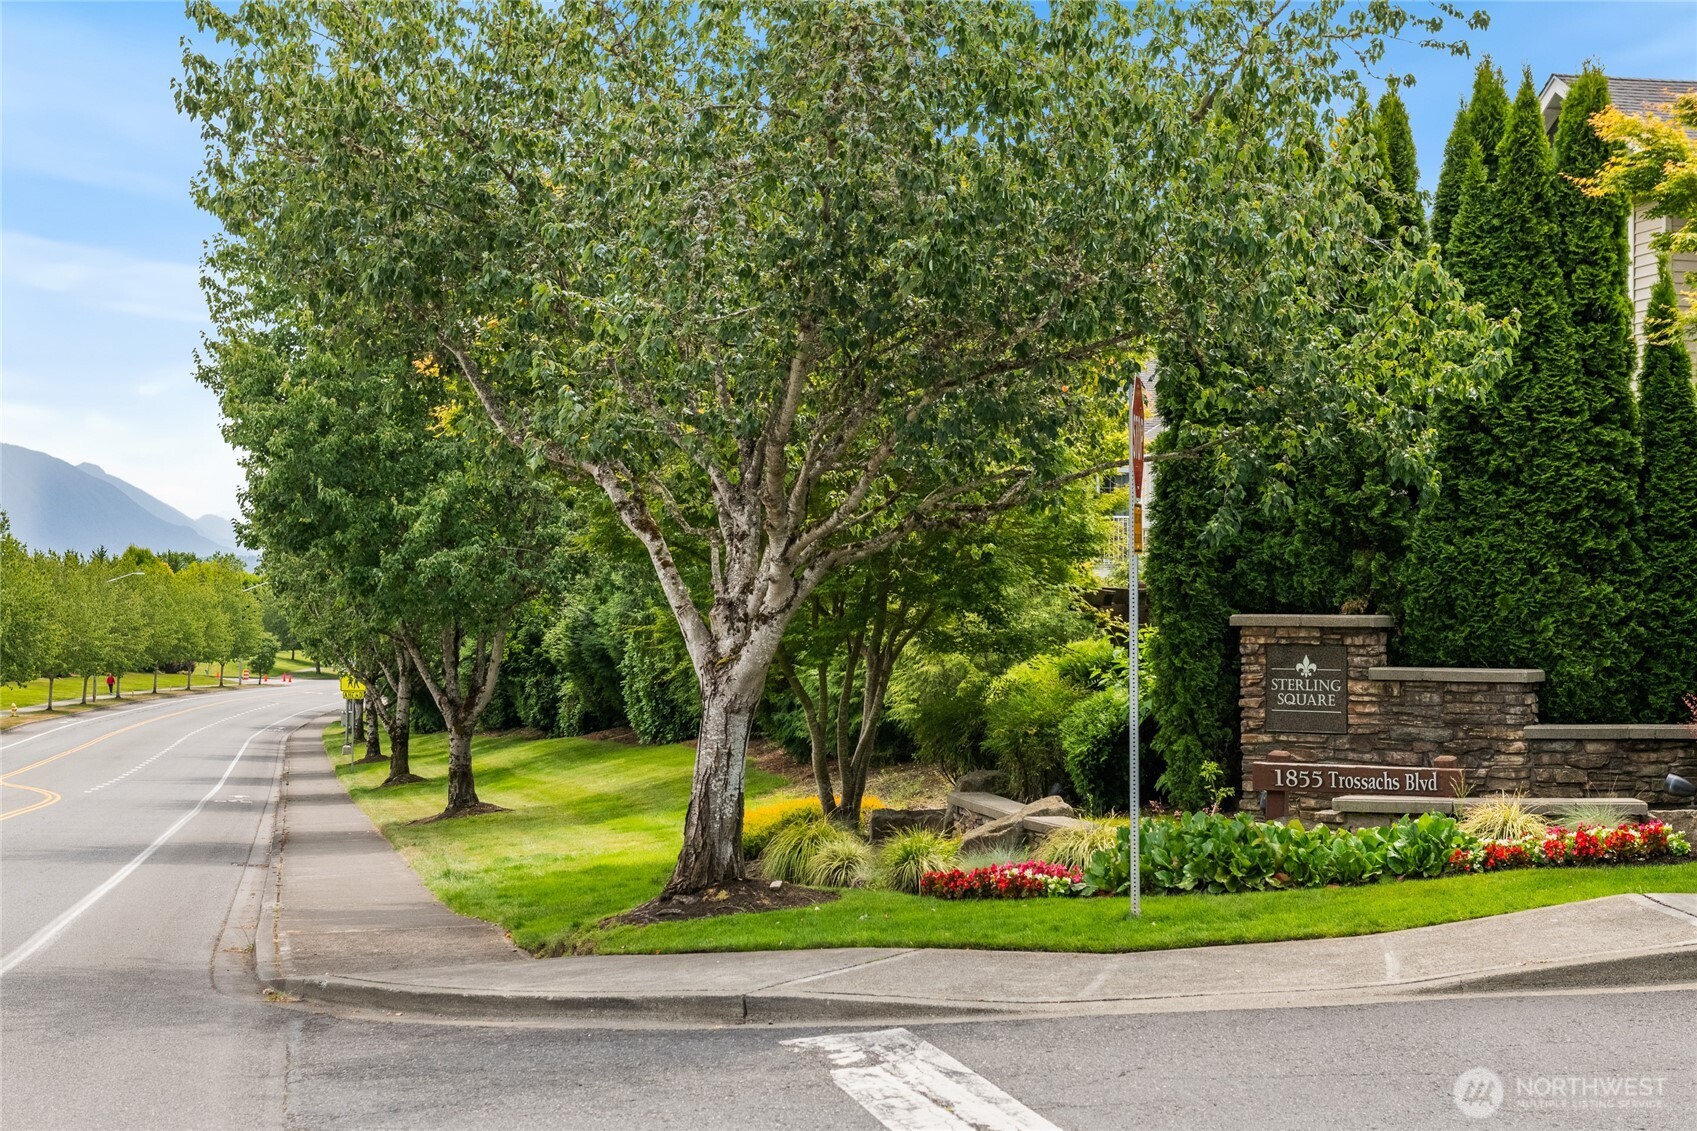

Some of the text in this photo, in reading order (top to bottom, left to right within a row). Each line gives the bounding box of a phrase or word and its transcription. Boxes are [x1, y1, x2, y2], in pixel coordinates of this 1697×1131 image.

[1271, 678, 1342, 692] STERLING
[1277, 693, 1336, 706] SQUARE
[1274, 769, 1438, 791] 1855 Trossachs Blvd
